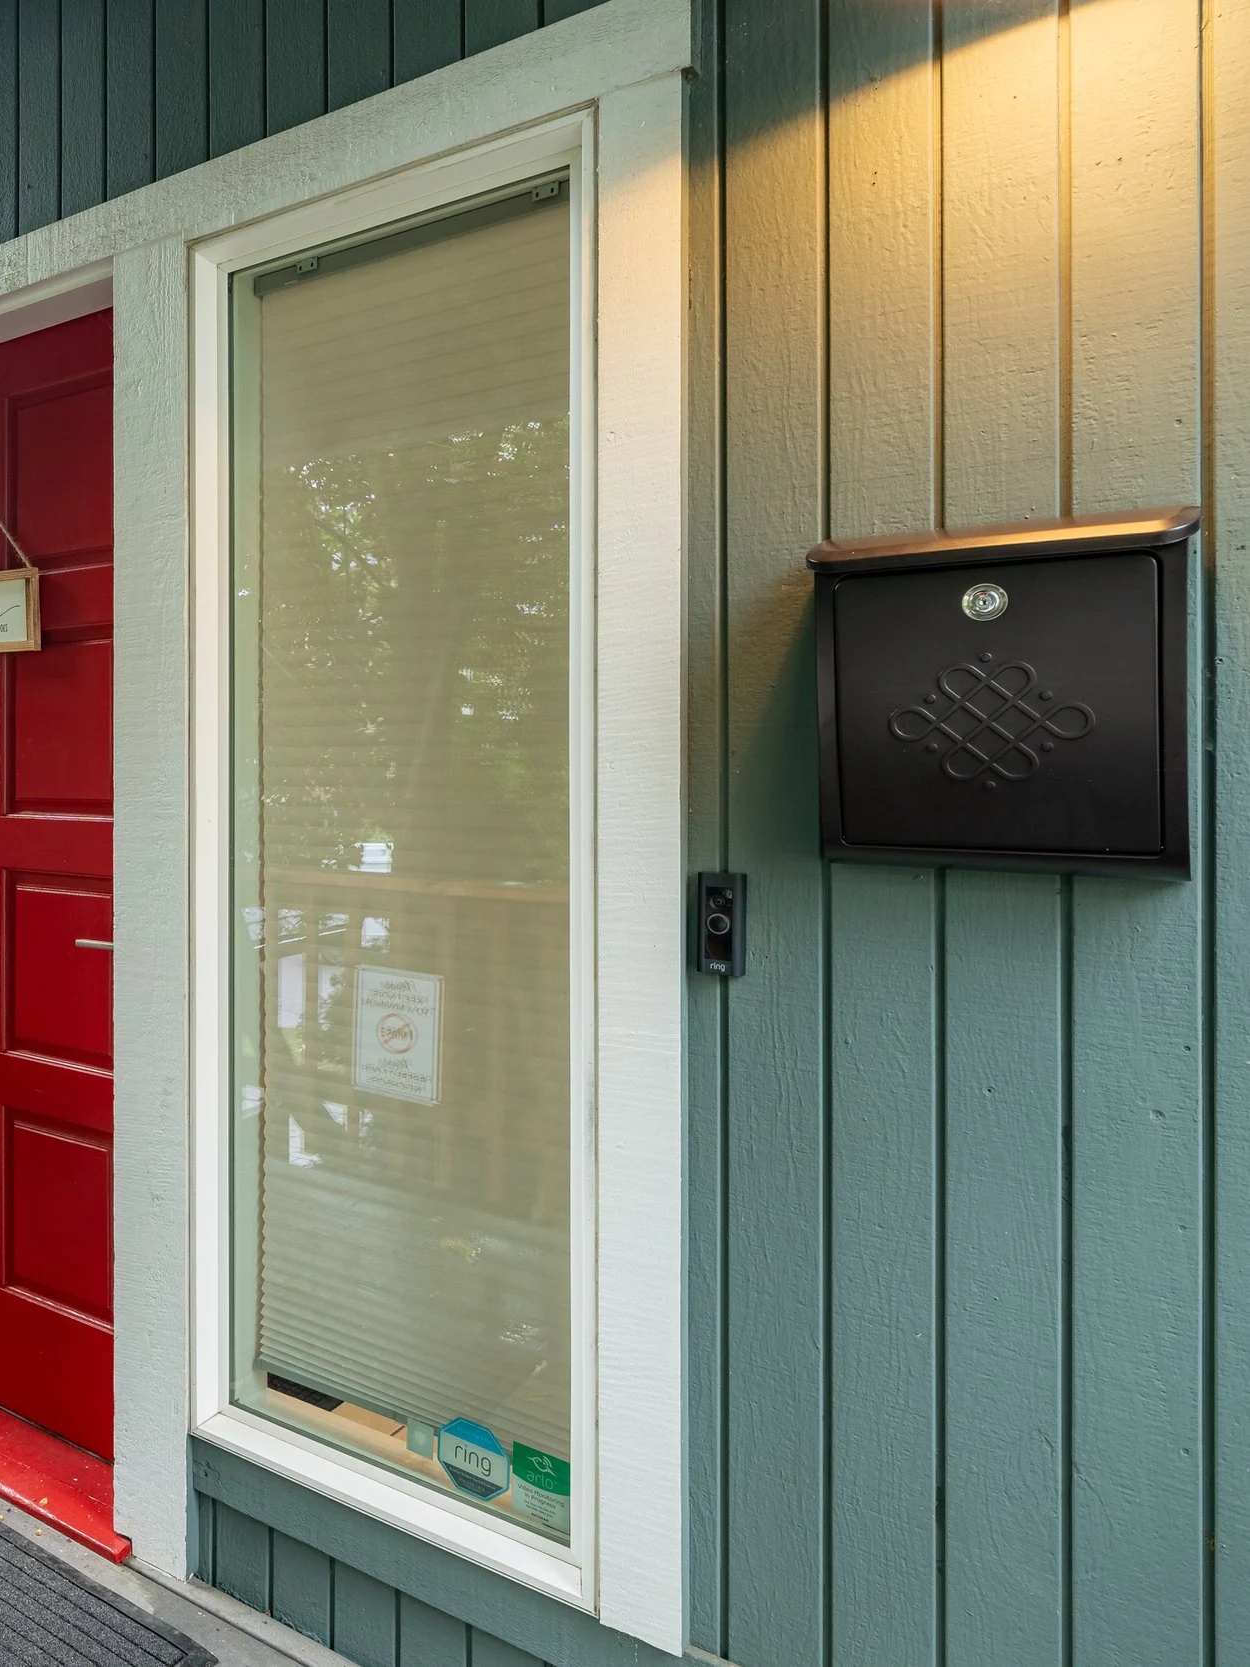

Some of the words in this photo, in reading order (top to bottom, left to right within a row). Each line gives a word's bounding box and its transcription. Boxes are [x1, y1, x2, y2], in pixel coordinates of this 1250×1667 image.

[710, 962, 726, 972] ring
[455, 1444, 492, 1477] ring
[526, 1470, 554, 1490] arlo
[518, 1482, 534, 1494] Video
[534, 1489, 565, 1508] Monitoring
[531, 1495, 556, 1510] Progress
